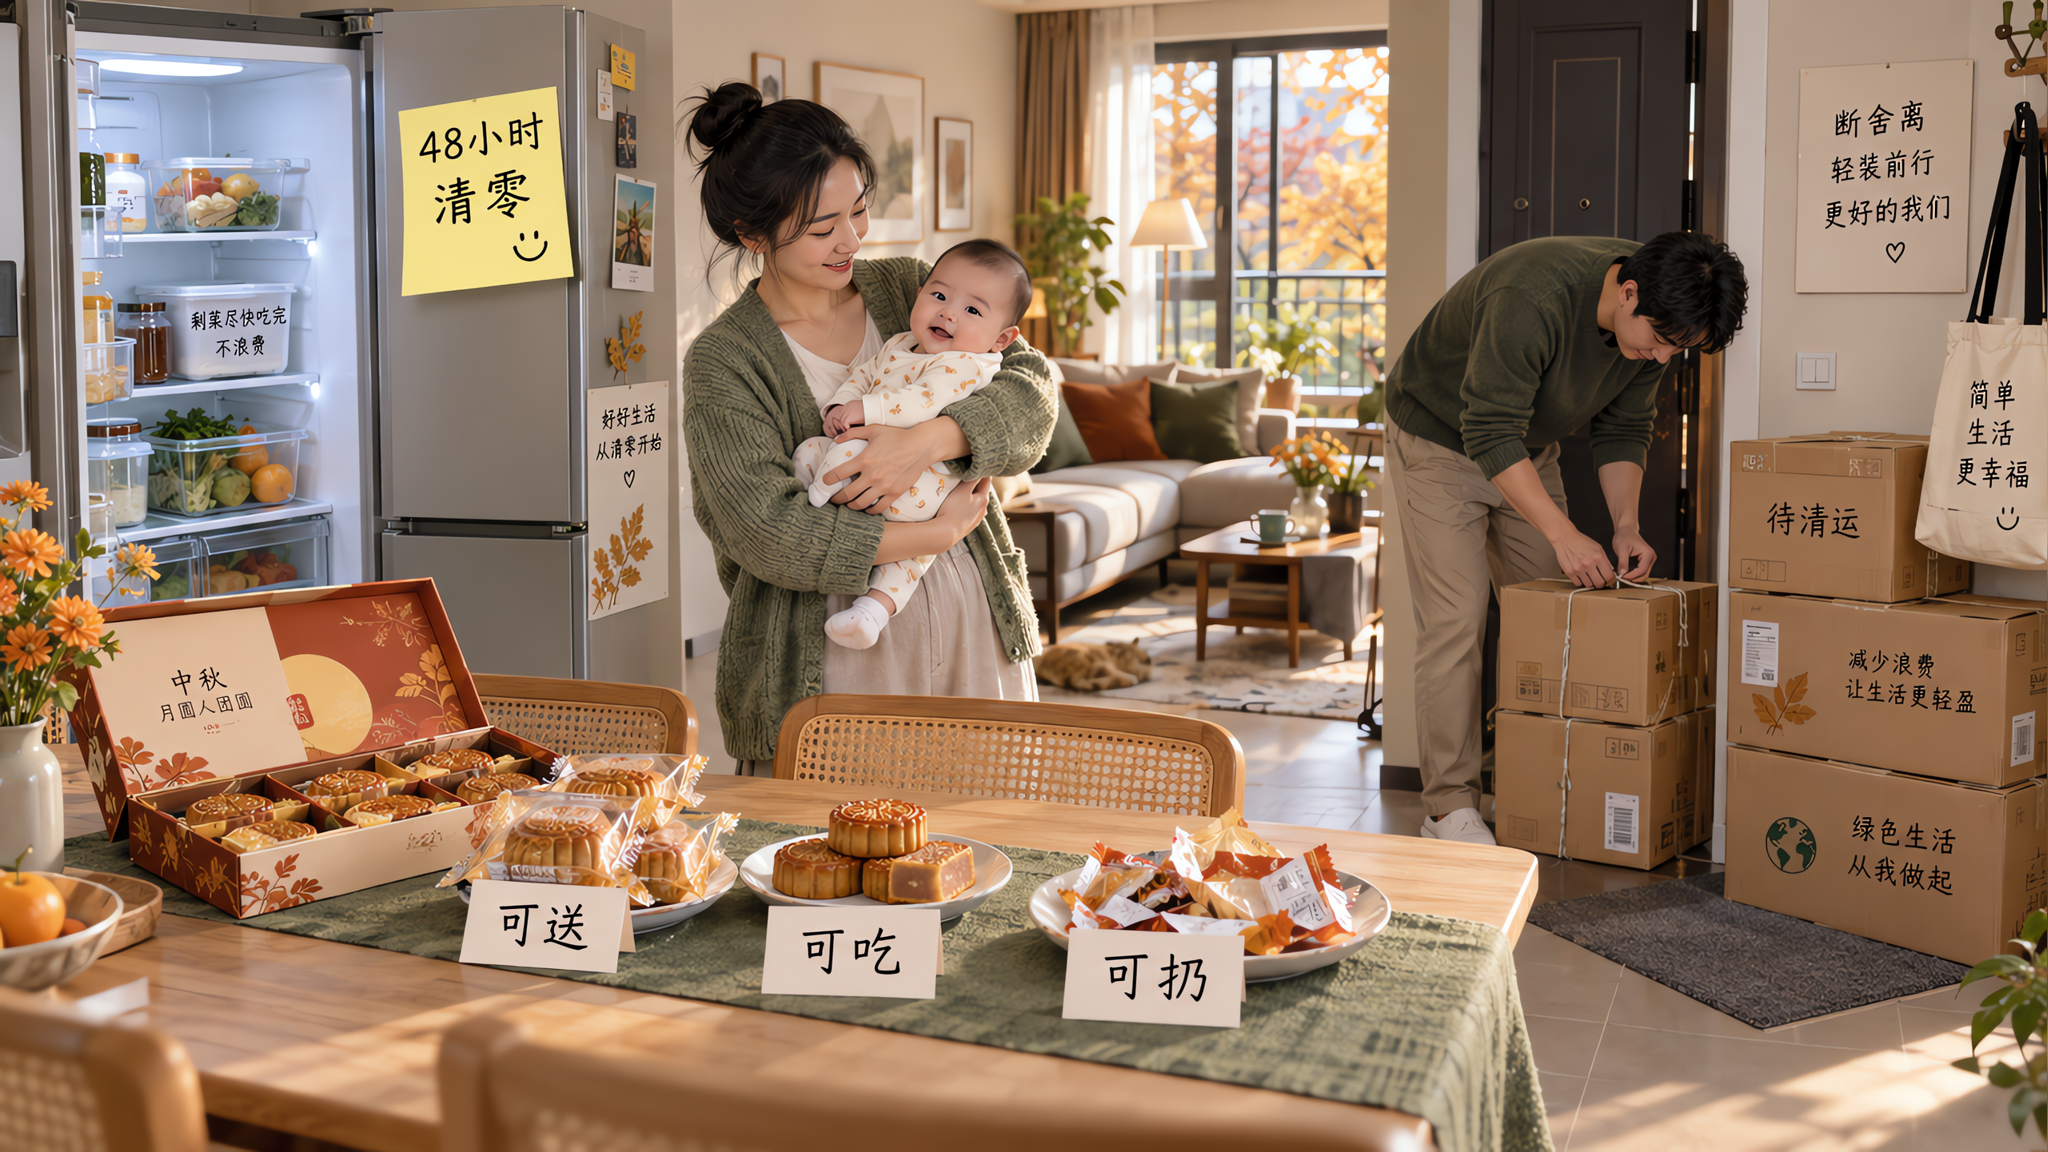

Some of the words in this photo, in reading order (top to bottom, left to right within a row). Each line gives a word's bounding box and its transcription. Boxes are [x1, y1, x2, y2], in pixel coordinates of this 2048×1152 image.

[419, 111, 543, 163] 48小时
[1835, 100, 1924, 138] 断舍离
[1831, 149, 1935, 184] 轻装前行
[435, 169, 530, 225] 清零
[1824, 194, 1950, 230] 更好的我们
[215, 334, 265, 358] 不浪费
[1970, 379, 2016, 411] 简单
[601, 403, 656, 430] 好好生活
[1966, 418, 2015, 447] 生活
[595, 432, 662, 461] 从清零开始
[1956, 457, 2029, 489] 更幸福
[1766, 501, 1861, 540] 待清运
[170, 666, 228, 697] 中秋
[1848, 649, 1935, 680] 减少浪费
[1845, 678, 1977, 714] 让生活更轻盈
[1851, 815, 1956, 855] 绿色生活
[1847, 854, 1954, 896] 从我做起
[499, 903, 589, 951] 可送
[802, 926, 902, 976] 可吃
[1104, 953, 1207, 1003] 可扔
